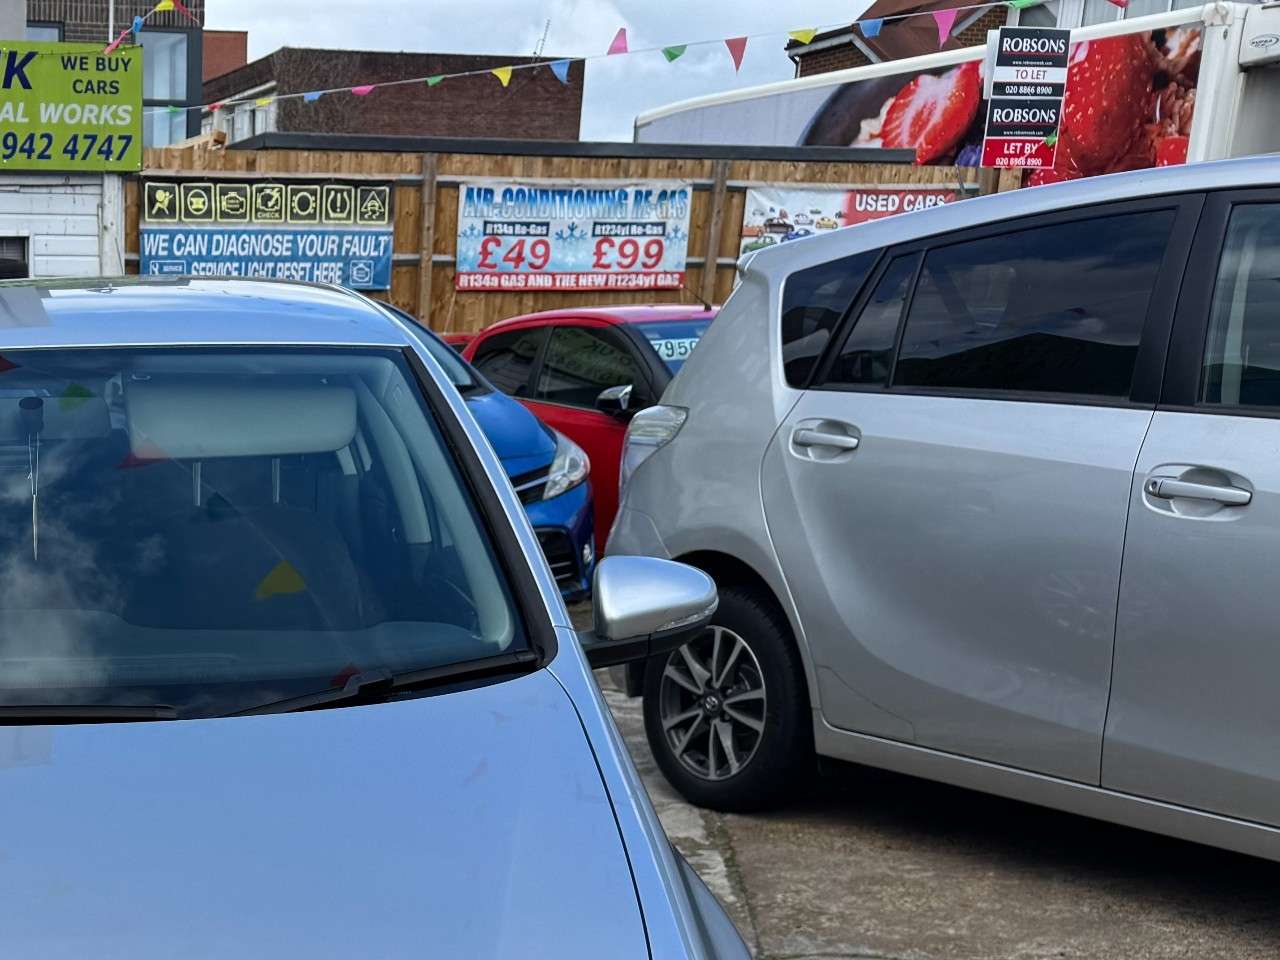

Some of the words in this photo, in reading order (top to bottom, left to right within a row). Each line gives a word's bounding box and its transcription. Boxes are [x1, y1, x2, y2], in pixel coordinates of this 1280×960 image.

[1002, 37, 1066, 54] ROBSONS
[61, 55, 90, 72] WE
[95, 56, 132, 73] BUY
[1015, 69, 1028, 80] TO
[1031, 69, 1047, 81] LET
[72, 79, 120, 96] CARS
[1005, 85, 1018, 94] 020
[1036, 86, 1053, 95] 8900
[39, 102, 132, 126] WORKS
[992, 108, 1057, 123] ROBSONS
[62, 134, 133, 162] 4747
[1003, 142, 1023, 155] LET
[1024, 143, 1038, 155] BY
[995, 157, 1009, 165] 020
[854, 193, 900, 212] USED
[902, 194, 946, 212] CARS
[515, 223, 548, 236] Re-Gas
[631, 224, 664, 236] Re-Gas
[143, 233, 170, 256] WE
[173, 233, 209, 256] CAN
[211, 234, 293, 257] DIAGNOSE
[296, 234, 339, 257] YOUR
[341, 234, 389, 258] FAULT
[477, 235, 552, 271] £49
[591, 236, 665, 271] £99
[191, 261, 240, 276] SERVICE
[241, 262, 274, 278] LIGHT
[276, 262, 310, 282] RESET
[312, 262, 343, 283] HERE
[500, 273, 526, 287] GAS
[527, 273, 553, 287] AND
[555, 273, 577, 287] THE
[579, 273, 607, 287] NEW
